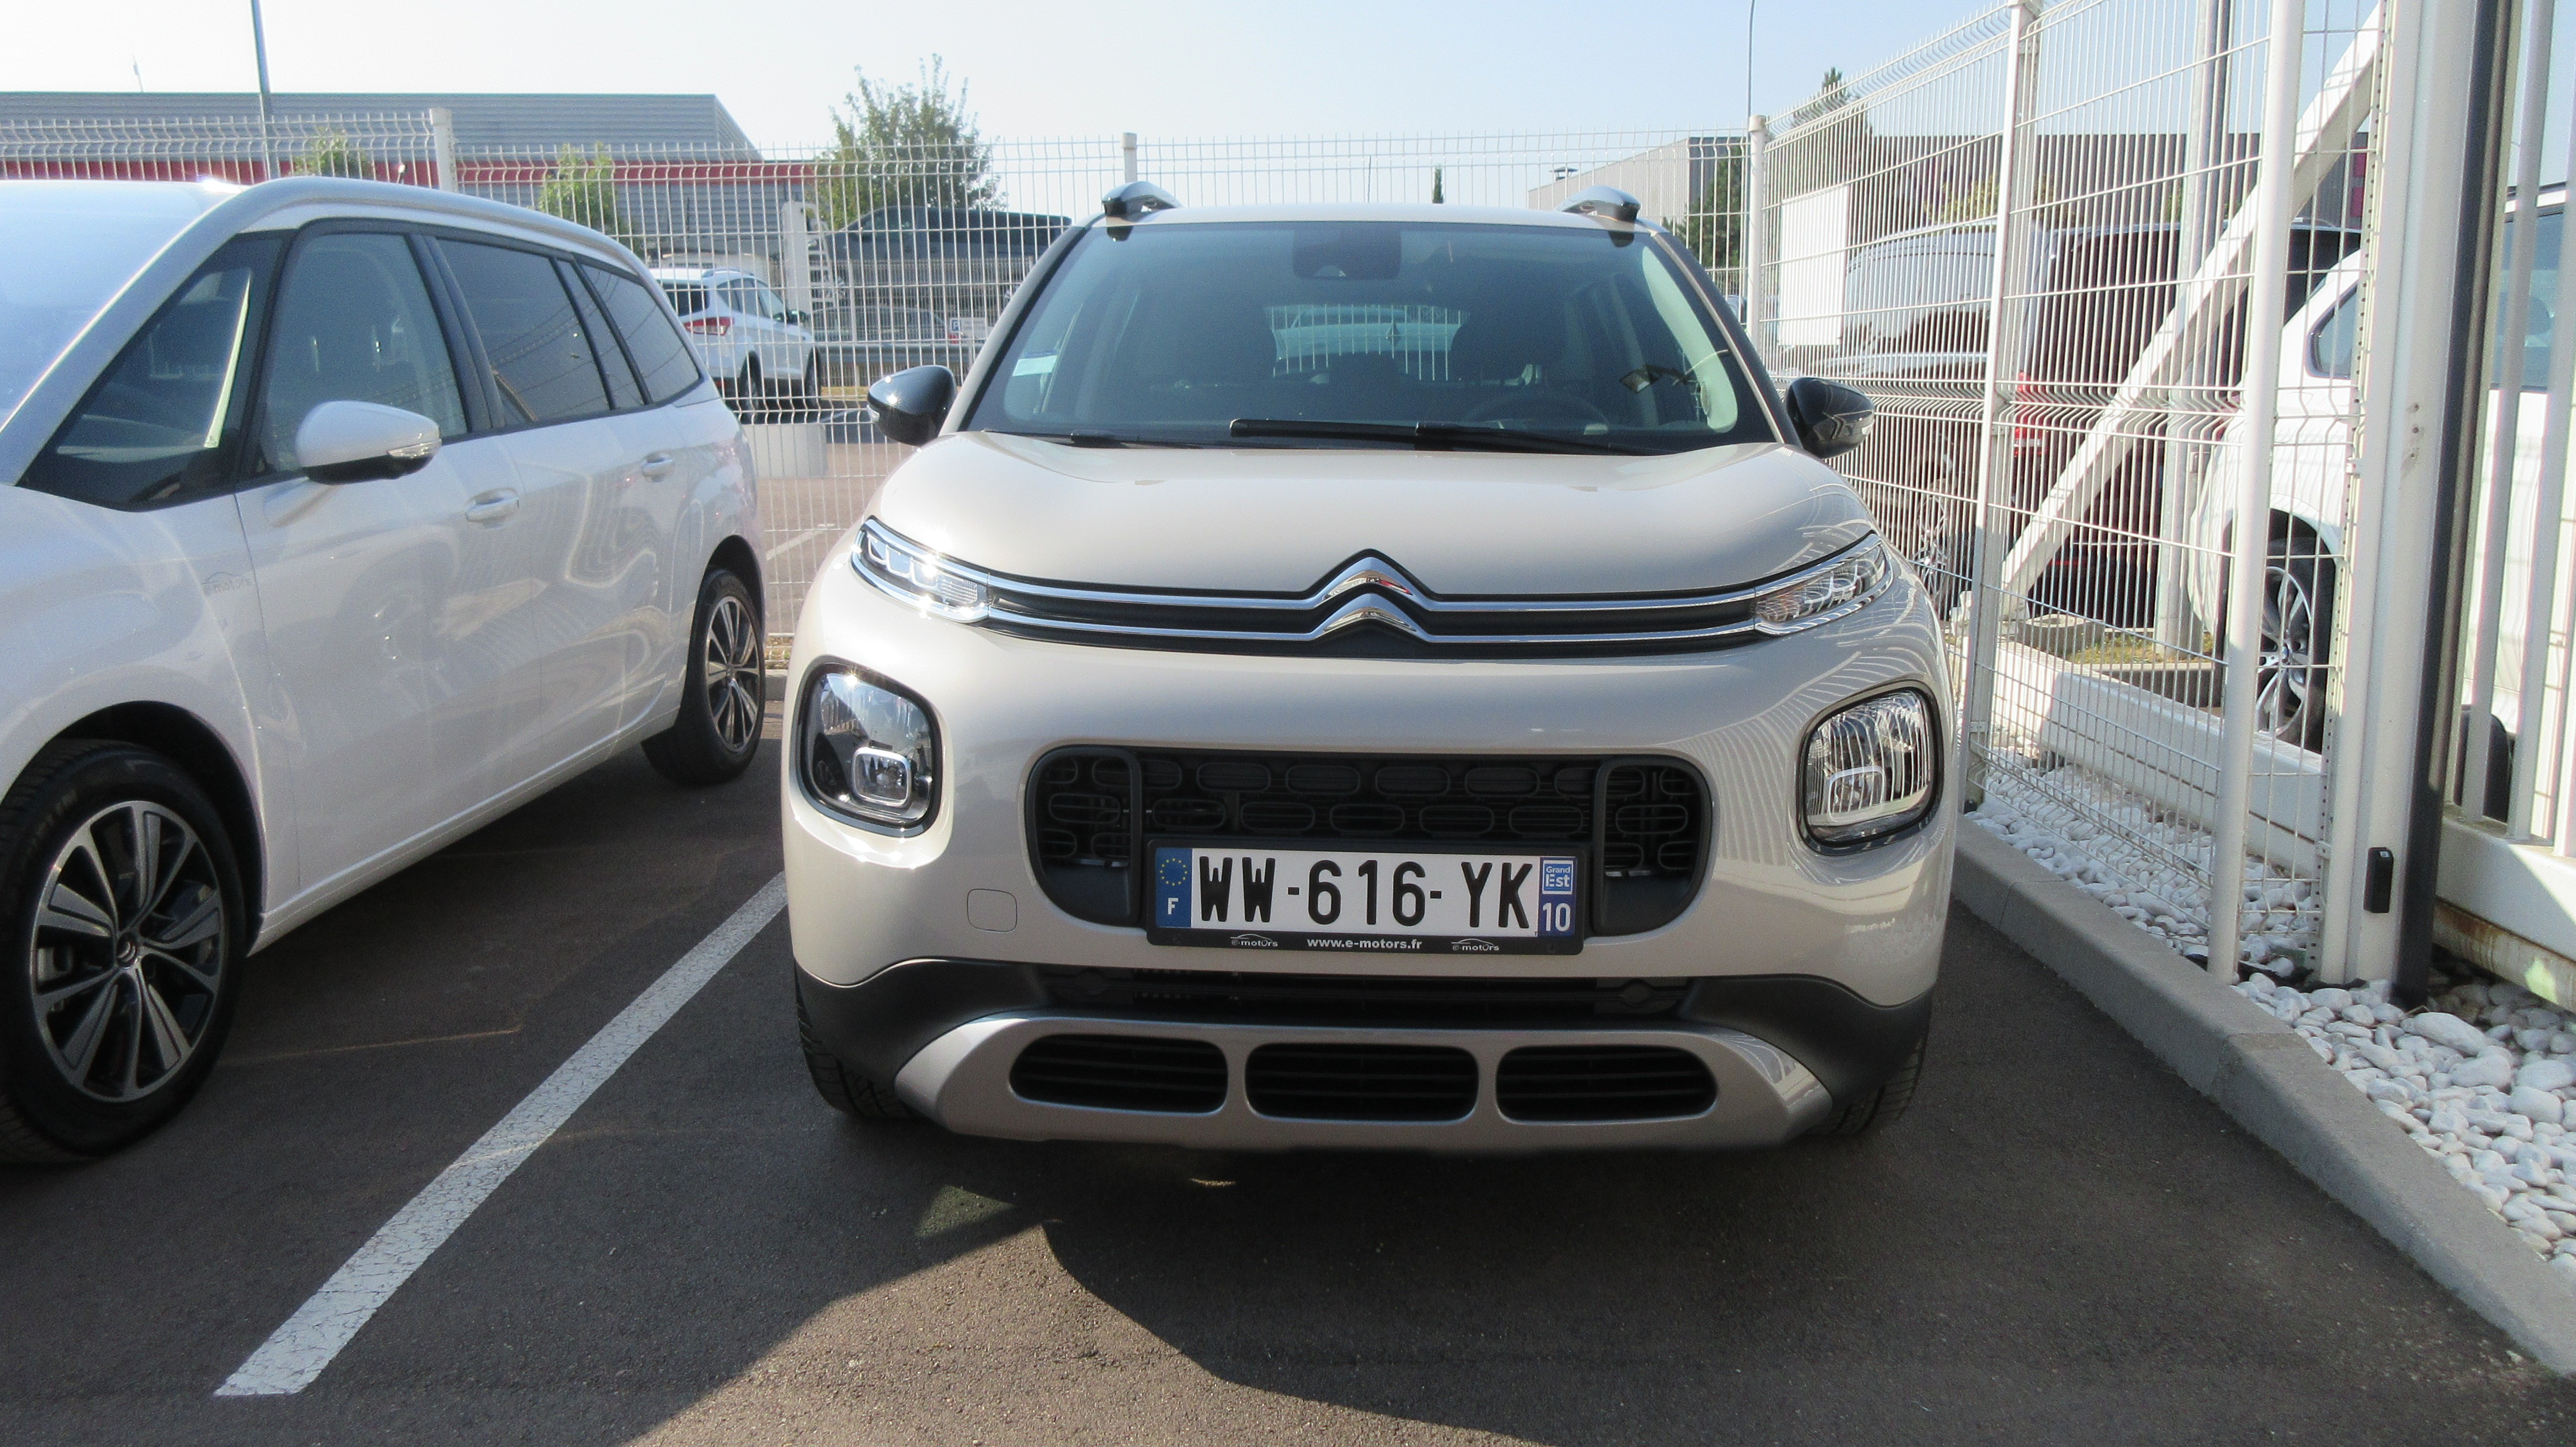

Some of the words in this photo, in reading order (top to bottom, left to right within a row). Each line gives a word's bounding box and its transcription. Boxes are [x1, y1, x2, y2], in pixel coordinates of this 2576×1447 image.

[1545, 874, 1570, 887] Est
[1199, 856, 1533, 929] WW-616-YK
[1168, 897, 1179, 915] F
[1542, 902, 1570, 931] 10
[1306, 938, 1422, 949] www.e-motors.fr
